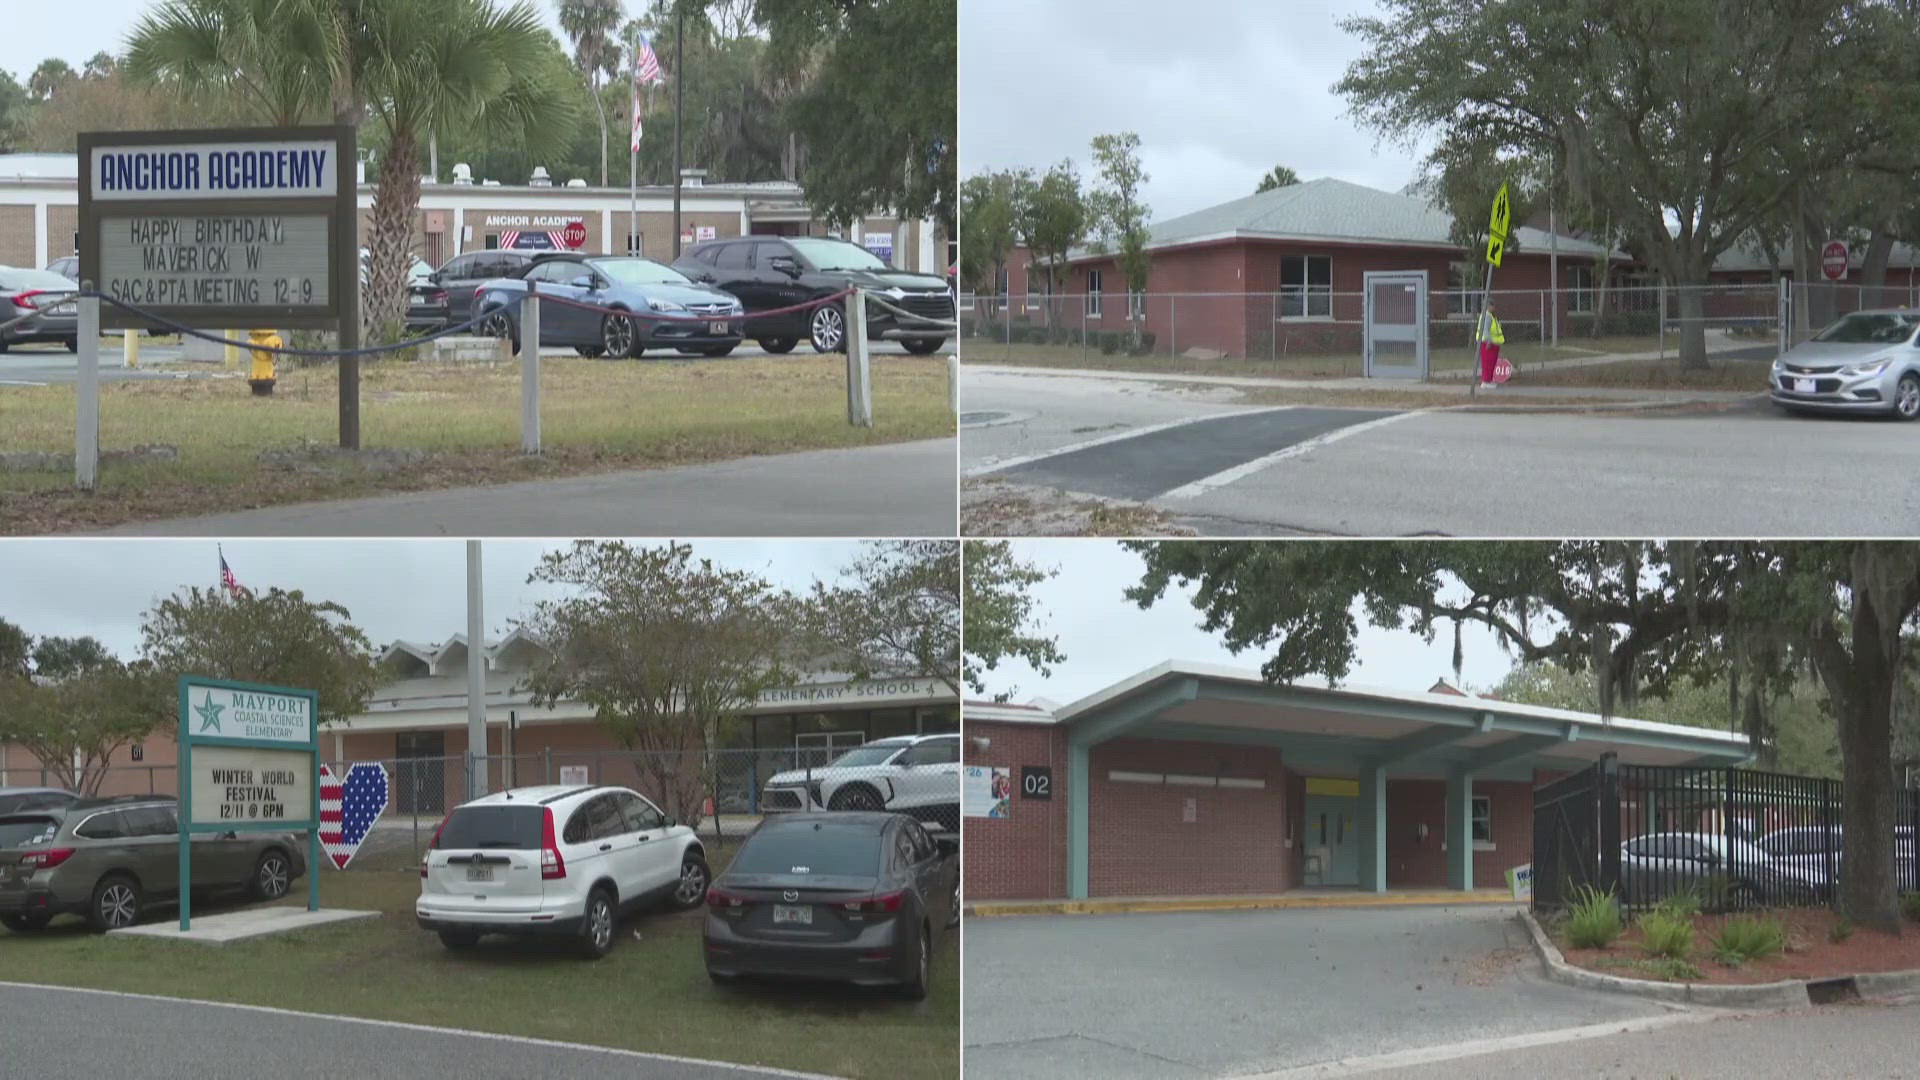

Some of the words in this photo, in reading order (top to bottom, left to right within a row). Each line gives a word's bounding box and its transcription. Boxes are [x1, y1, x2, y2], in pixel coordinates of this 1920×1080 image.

[101, 153, 200, 191] ANCHOR
[209, 150, 326, 189] ACADEMY
[486, 216, 529, 226] ANCHOR
[131, 219, 180, 244] HAPPY
[195, 219, 282, 243] BIRTHDAY
[565, 230, 585, 240] STOP
[143, 247, 228, 271] MAVERICK
[246, 248, 260, 270] W
[194, 279, 259, 304] MEETING
[857, 682, 919, 697] SCHOOL
[232, 693, 305, 713] MAYPORT
[234, 711, 269, 724] COASTAL
[271, 715, 304, 728] SCIENCES
[246, 727, 293, 739] ELEMENTARY
[212, 769, 253, 785] WINTER
[262, 770, 295, 786] WORLD
[1025, 774, 1049, 794] 02
[226, 787, 277, 801] FESTIVAL
[220, 804, 244, 818] 12/11
[248, 804, 258, 818] @
[263, 803, 284, 818] 6PM
